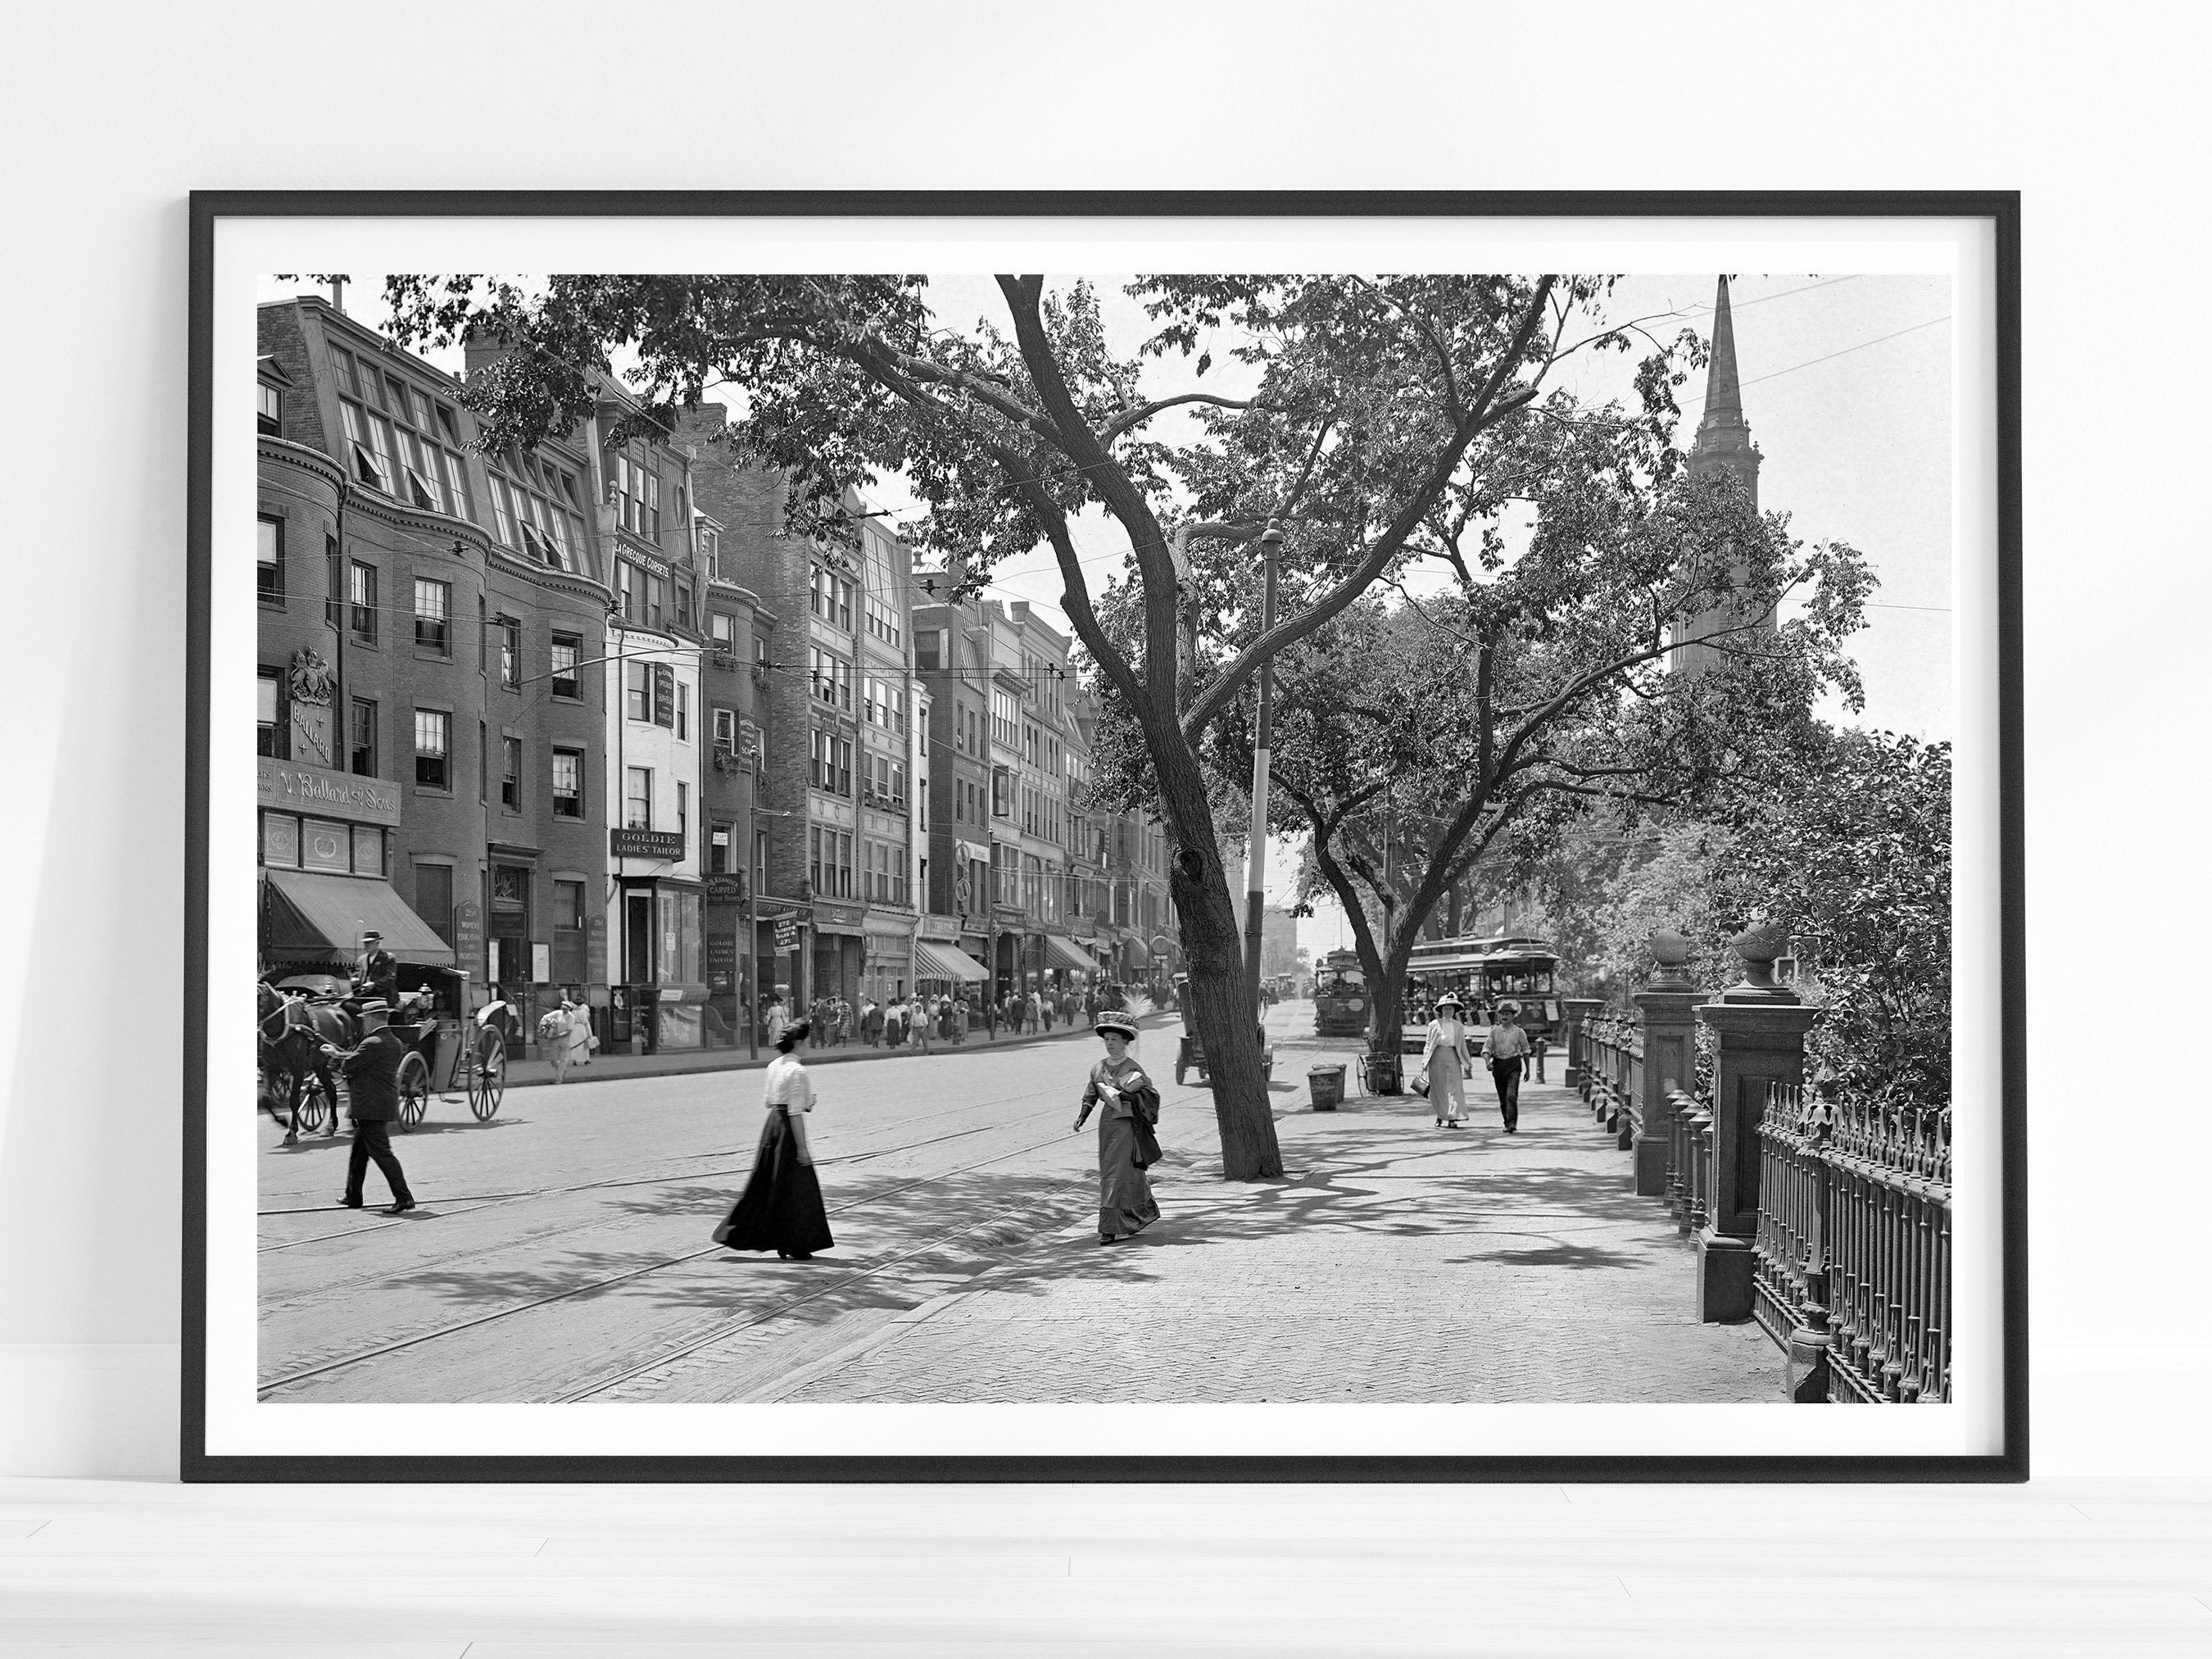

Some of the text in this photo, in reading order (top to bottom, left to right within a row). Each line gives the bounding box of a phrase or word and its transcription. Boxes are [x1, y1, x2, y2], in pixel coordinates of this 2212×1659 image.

[622, 543, 646, 566] GRECQUE
[646, 556, 670, 578] CORSETS.
[293, 704, 330, 763] BALLARD
[297, 773, 351, 805] Ballard
[351, 786, 365, 807] &
[365, 787, 397, 811] Sons
[622, 832, 676, 845] GOLDIE
[616, 844, 681, 856] LADIES' TAILOR
[709, 886, 737, 894] CARVED
[465, 909, 477, 918] 264
[1480, 944, 1491, 954] 9
